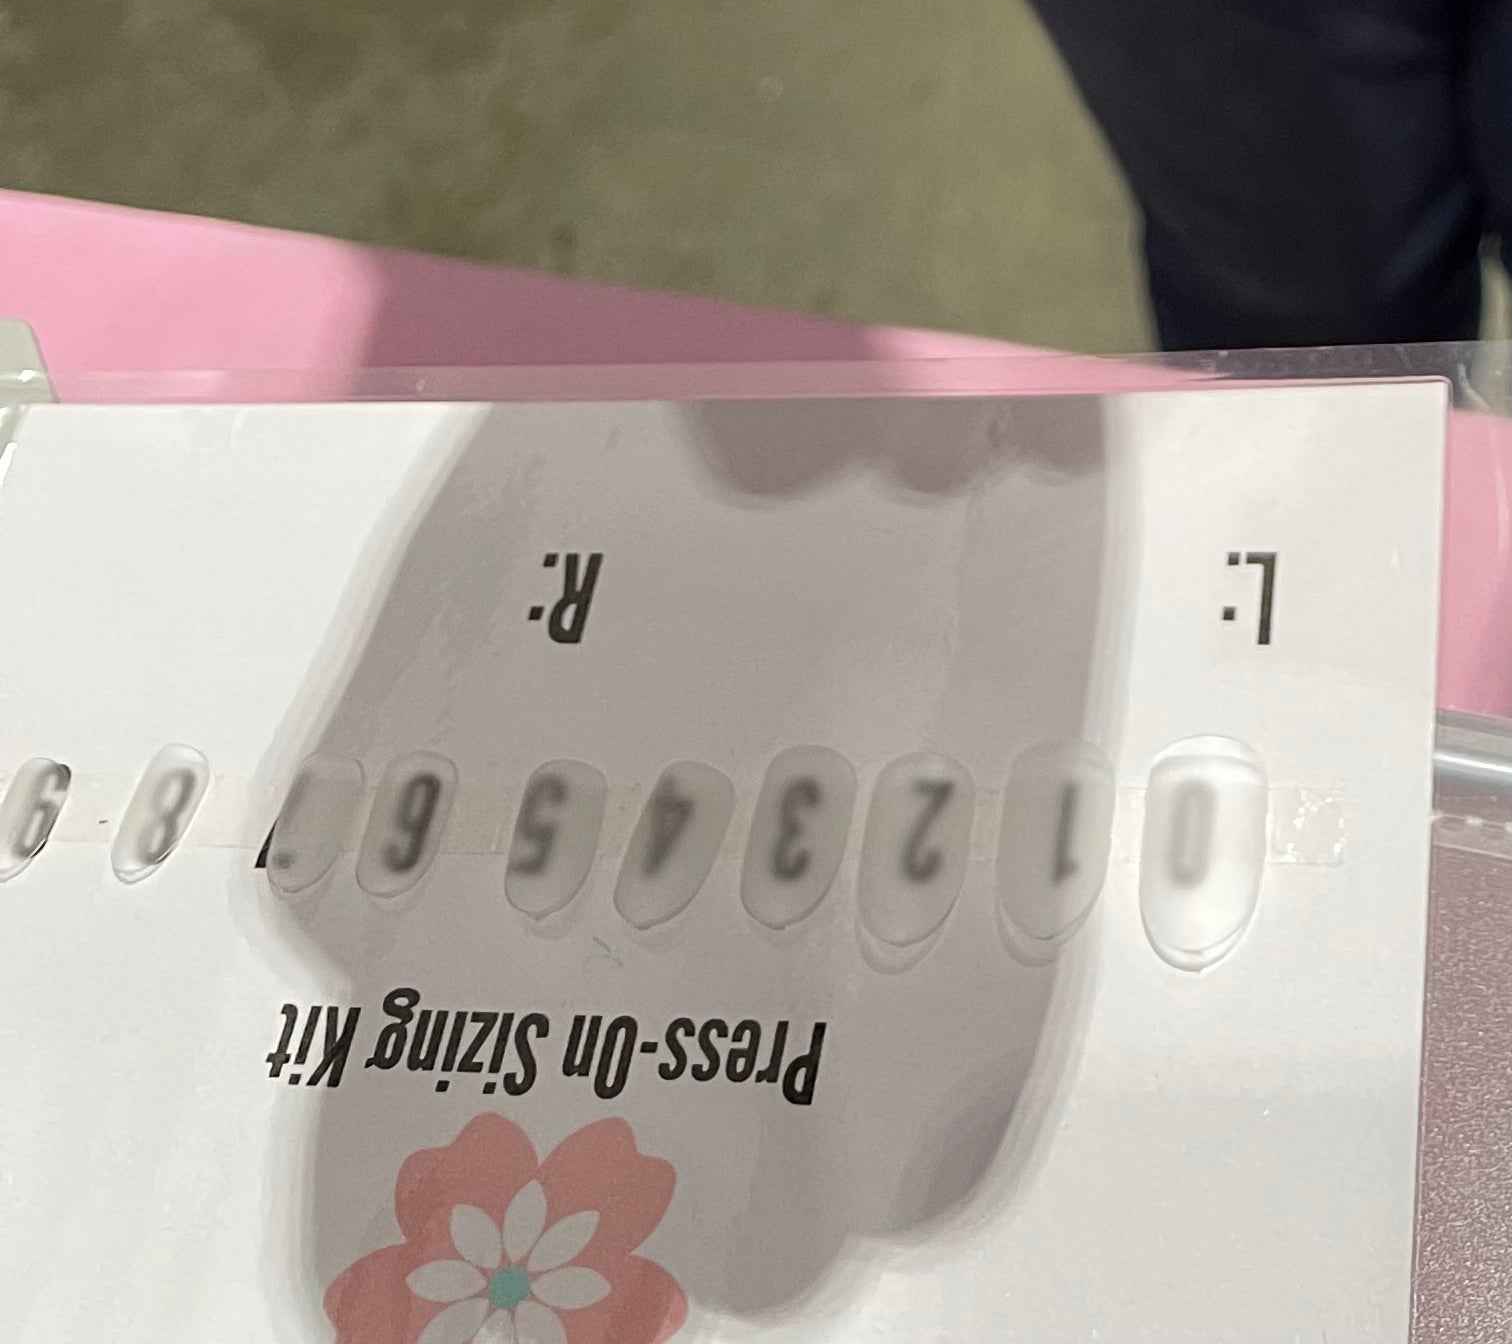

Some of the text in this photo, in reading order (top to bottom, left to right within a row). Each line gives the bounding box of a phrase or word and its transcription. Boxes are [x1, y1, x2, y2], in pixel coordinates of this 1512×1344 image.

[528, 553, 603, 644] R:
[1221, 552, 1278, 645] L:
[138, 768, 196, 864] 8
[386, 774, 441, 875] 6
[508, 775, 569, 876] 5
[641, 775, 695, 879] 4
[770, 774, 825, 882] 3
[901, 776, 956, 882] 2
[1052, 779, 1081, 885] 1
[266, 987, 827, 1106] Press-On Sizing Kit
